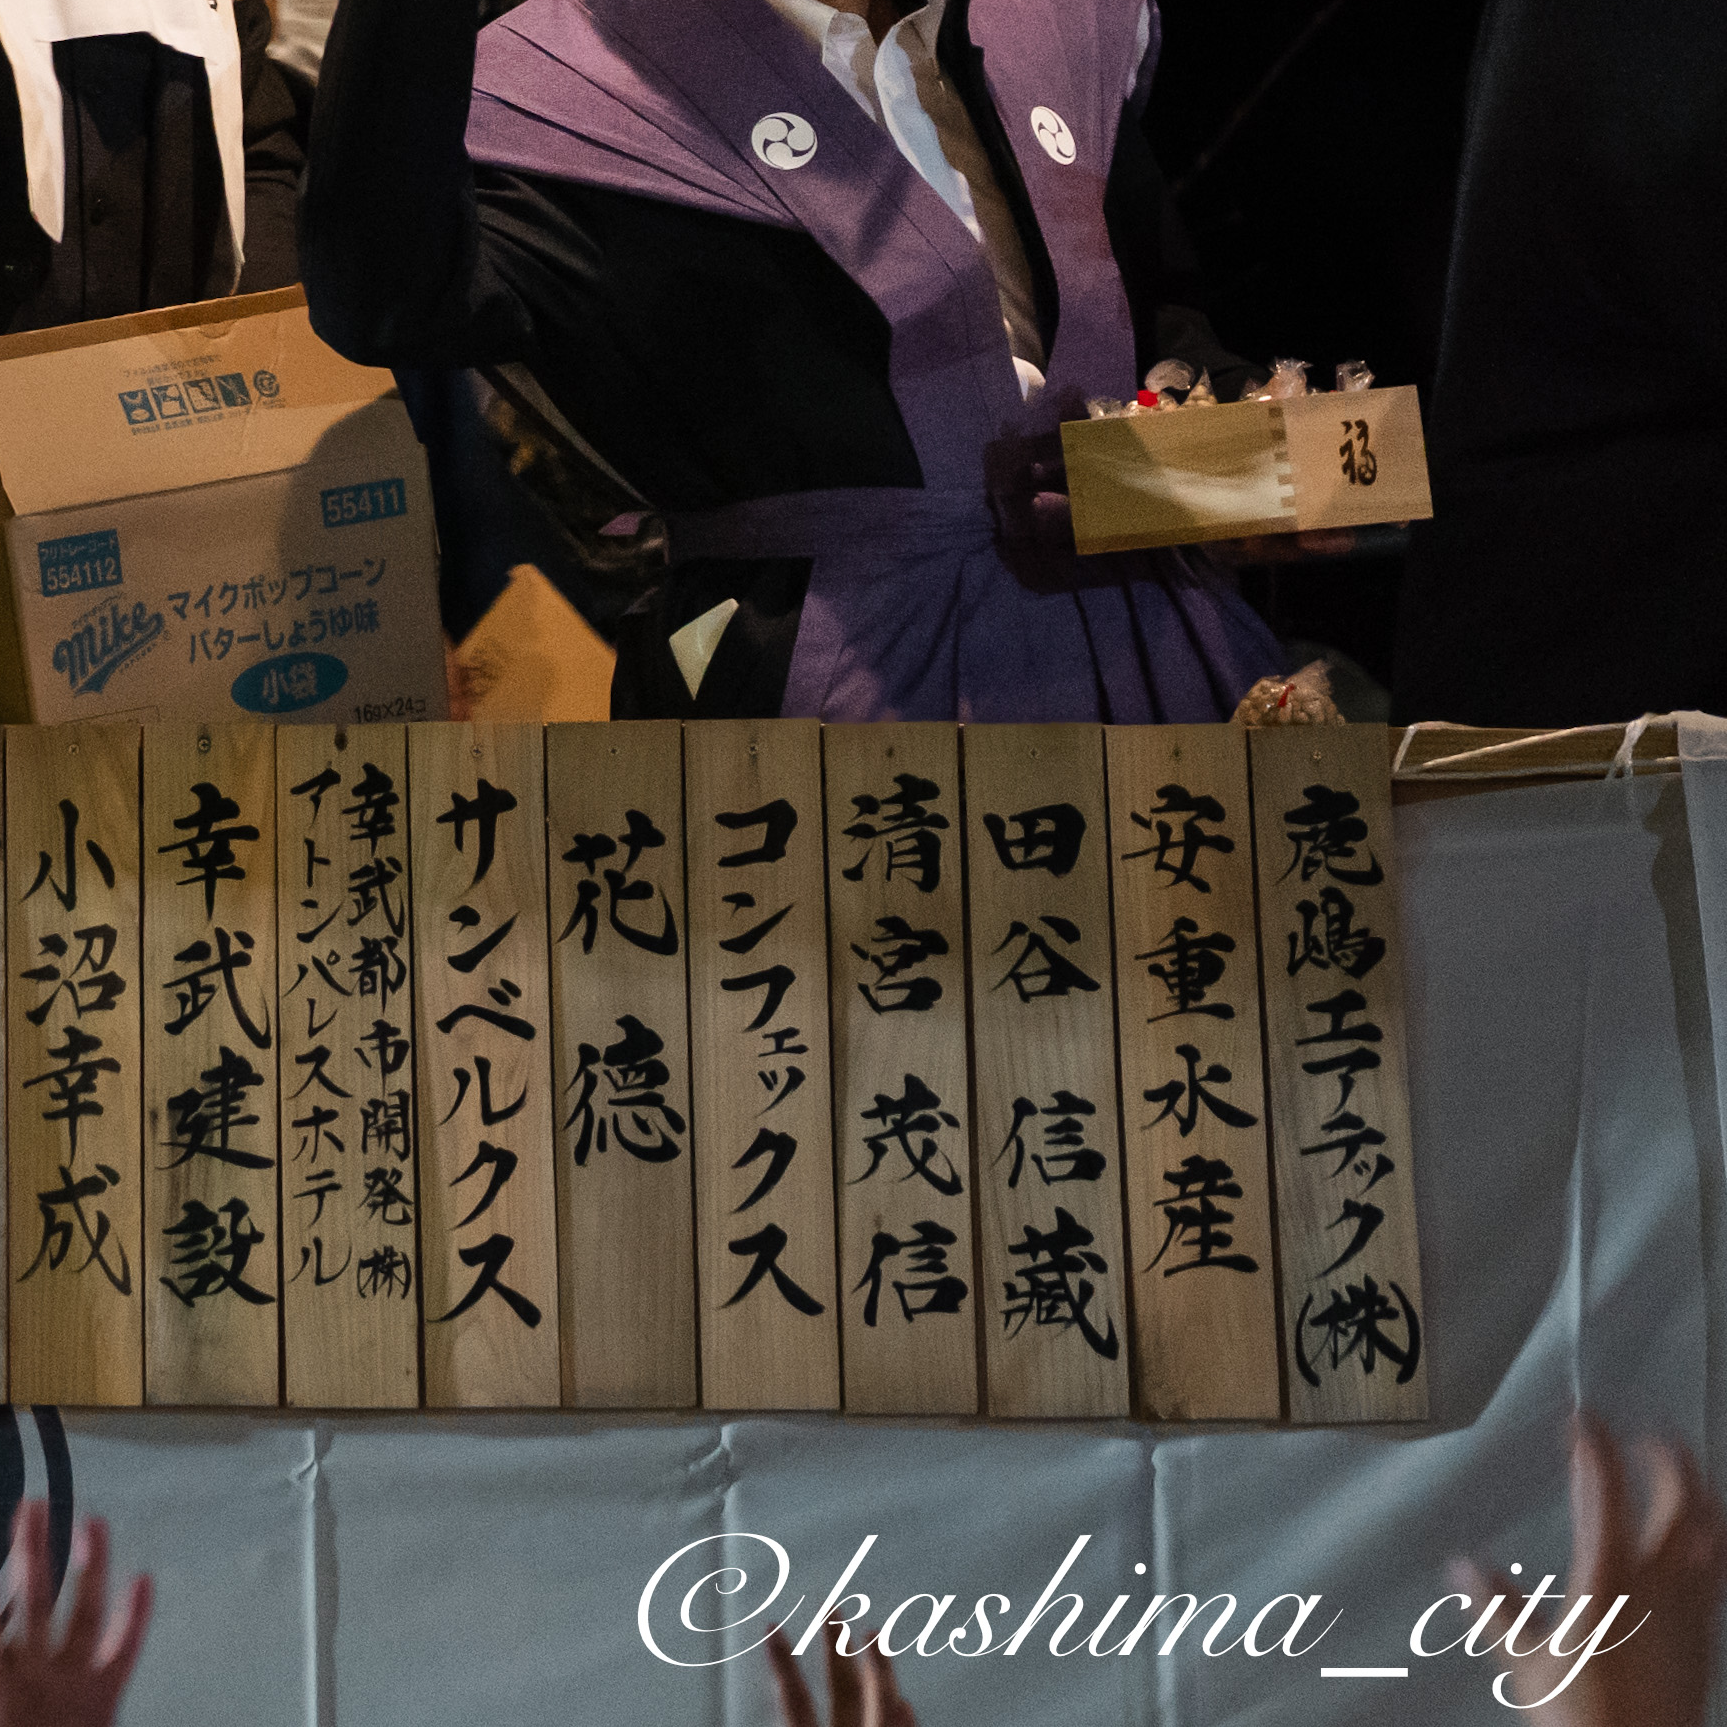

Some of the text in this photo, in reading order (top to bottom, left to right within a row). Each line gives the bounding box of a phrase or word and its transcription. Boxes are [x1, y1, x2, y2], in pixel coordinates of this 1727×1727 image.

[46, 558, 118, 591] 554112
[167, 556, 388, 623] マイクポップコーン
[188, 598, 381, 665] バターしょうゆ味
[1339, 419, 1376, 485] 福
[16, 799, 133, 1297] 小沼幸成
[155, 781, 277, 1308] 幸武建設
[283, 768, 352, 1287] アトンパレスホテル
[425, 777, 543, 1329] サンベルクス
[715, 799, 825, 1317] コンフェックス
[841, 773, 969, 1326] 清宮茂信
[1121, 783, 1259, 1279] 安重水産
